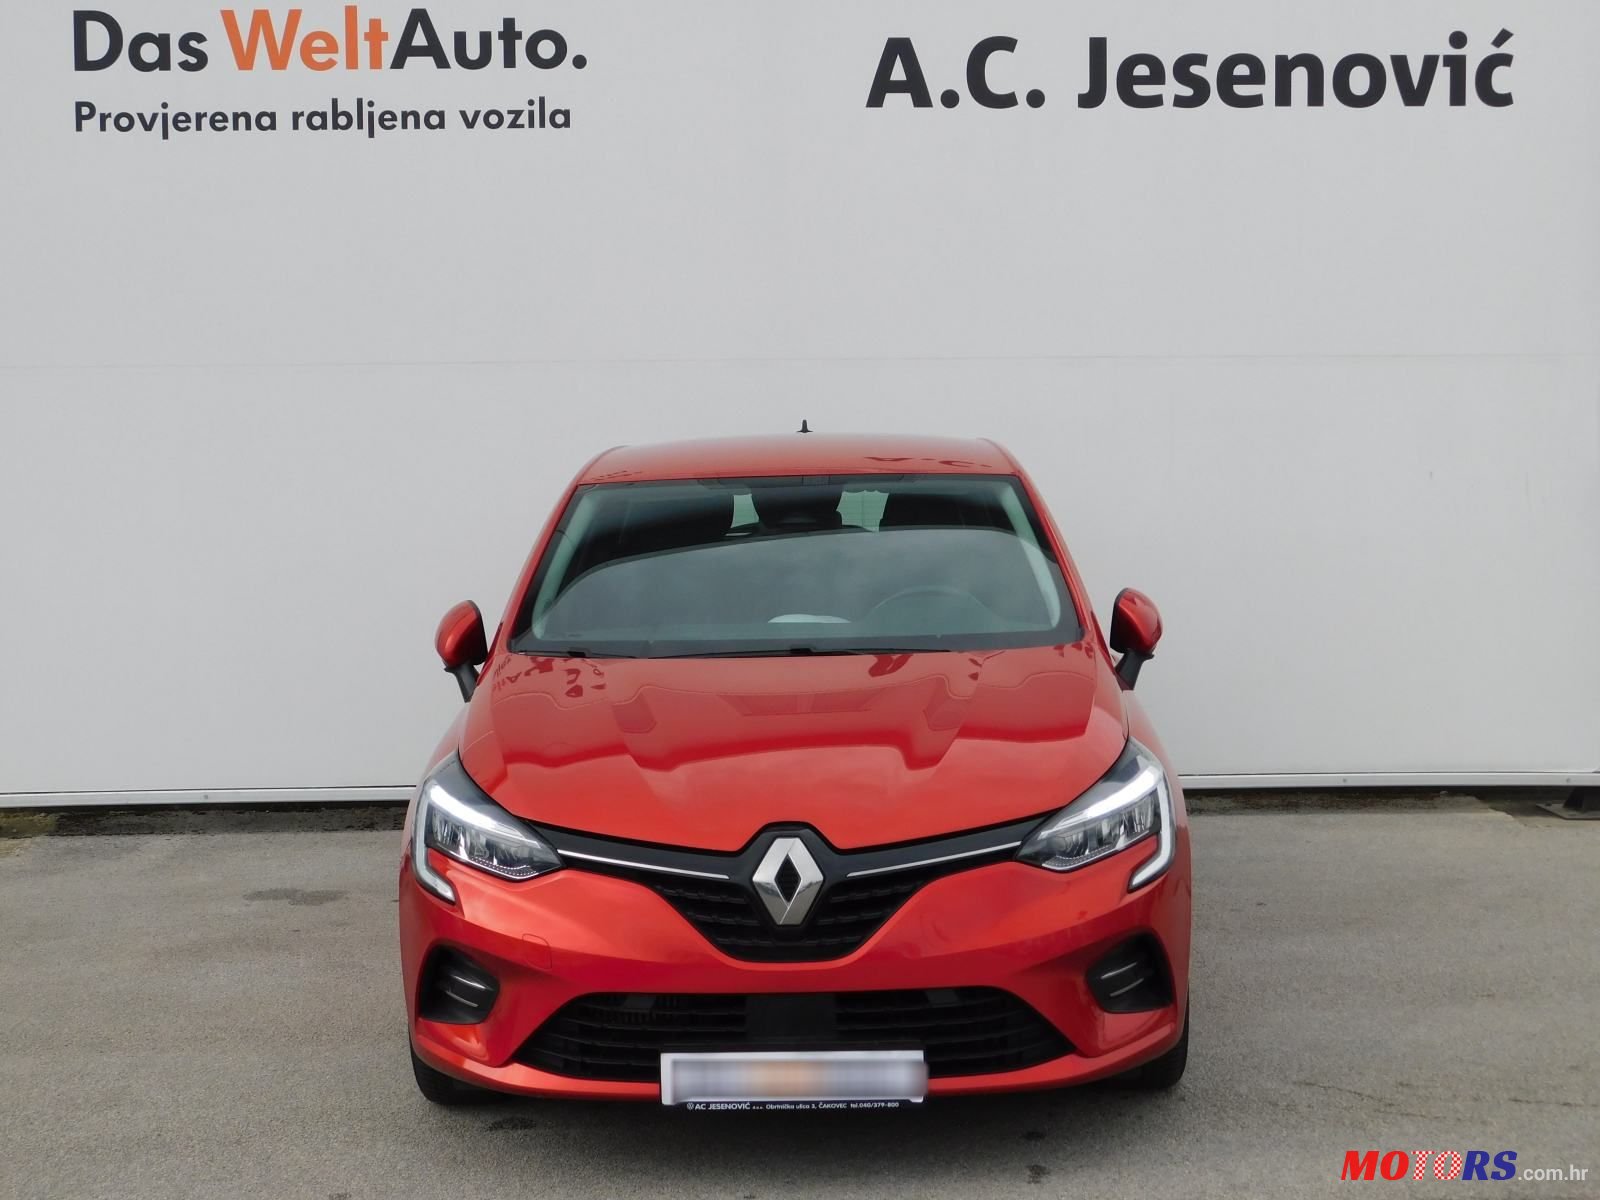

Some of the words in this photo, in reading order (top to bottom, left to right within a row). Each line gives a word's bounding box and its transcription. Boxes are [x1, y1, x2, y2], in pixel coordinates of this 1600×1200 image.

[73, 10, 208, 72] Das
[221, 6, 587, 71] WeltAuto.
[866, 36, 1045, 109] A.C.
[1078, 28, 1513, 108] Jesenović
[75, 101, 276, 140] Provjerena
[293, 98, 445, 138] rabljena
[459, 96, 570, 129] vozila
[708, 1102, 751, 1110] JESENOVIĆ
